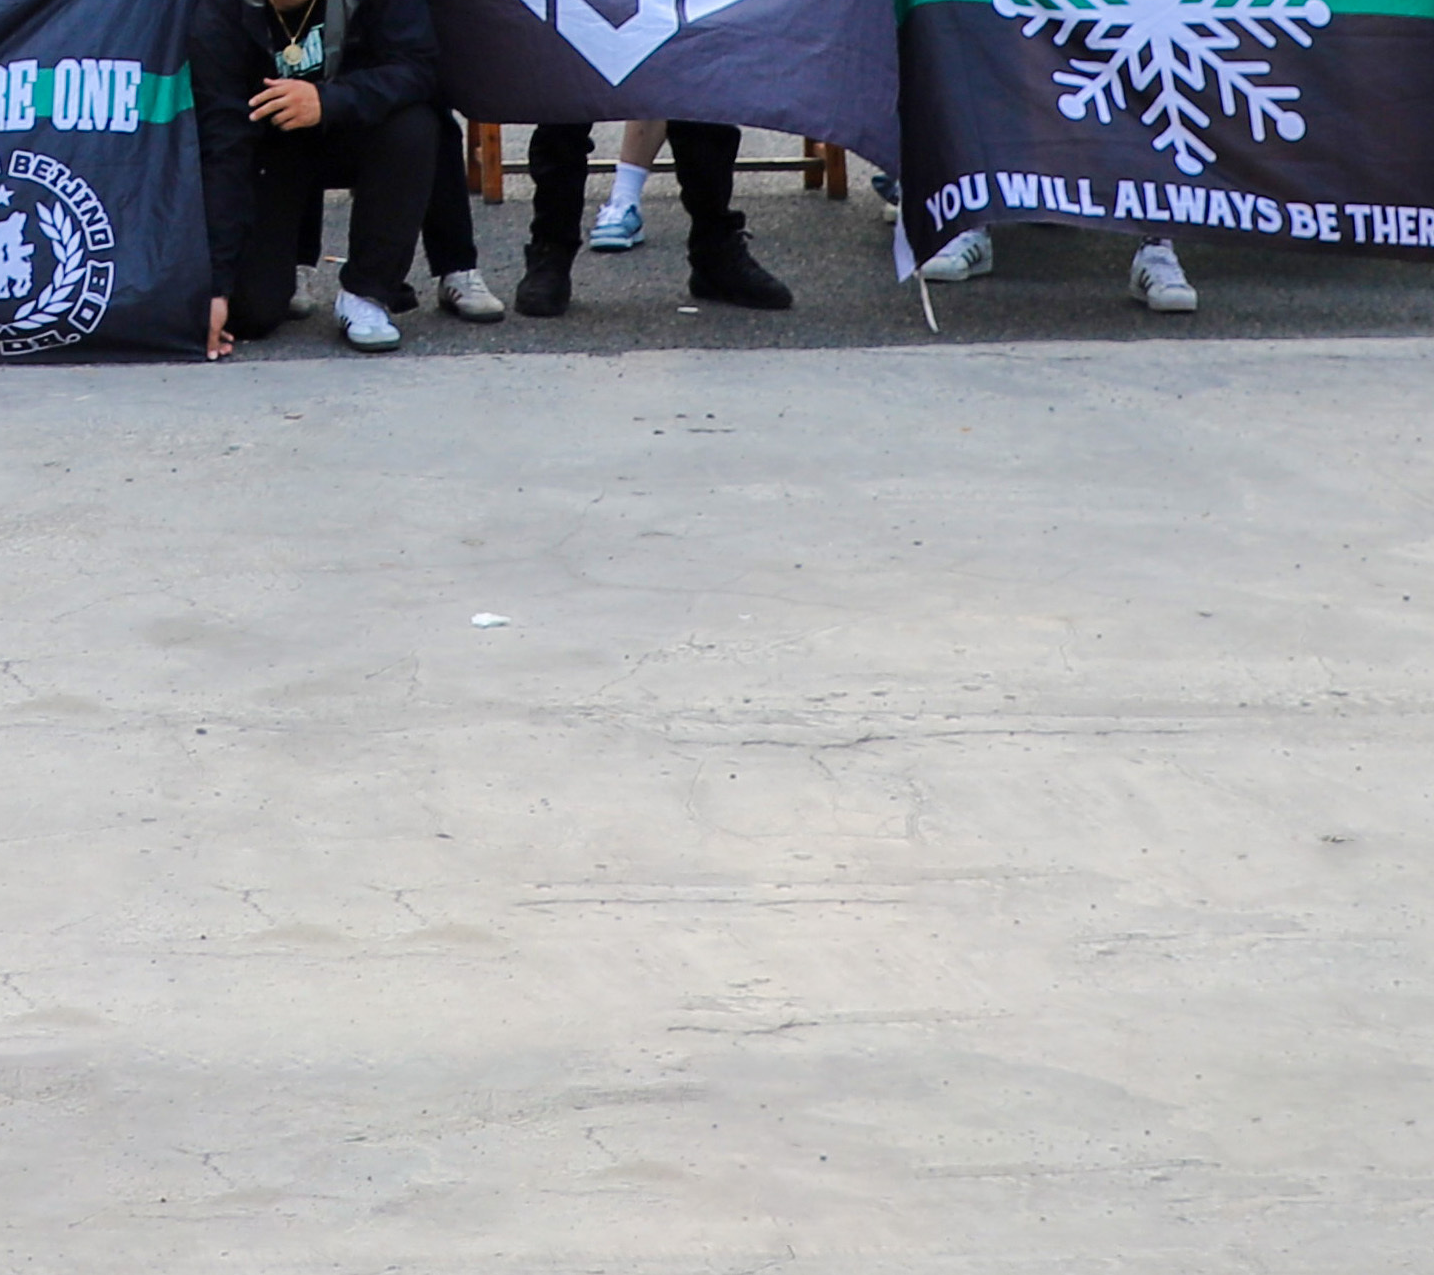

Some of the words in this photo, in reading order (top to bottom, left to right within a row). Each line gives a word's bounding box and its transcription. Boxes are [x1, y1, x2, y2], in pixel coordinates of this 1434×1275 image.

[51, 57, 142, 133] ONE
[7, 149, 116, 252] BEIJING
[926, 172, 991, 233] YOU
[996, 170, 1107, 218] WILL
[1113, 179, 1285, 235] ALWAYS
[1285, 201, 1341, 242] BE
